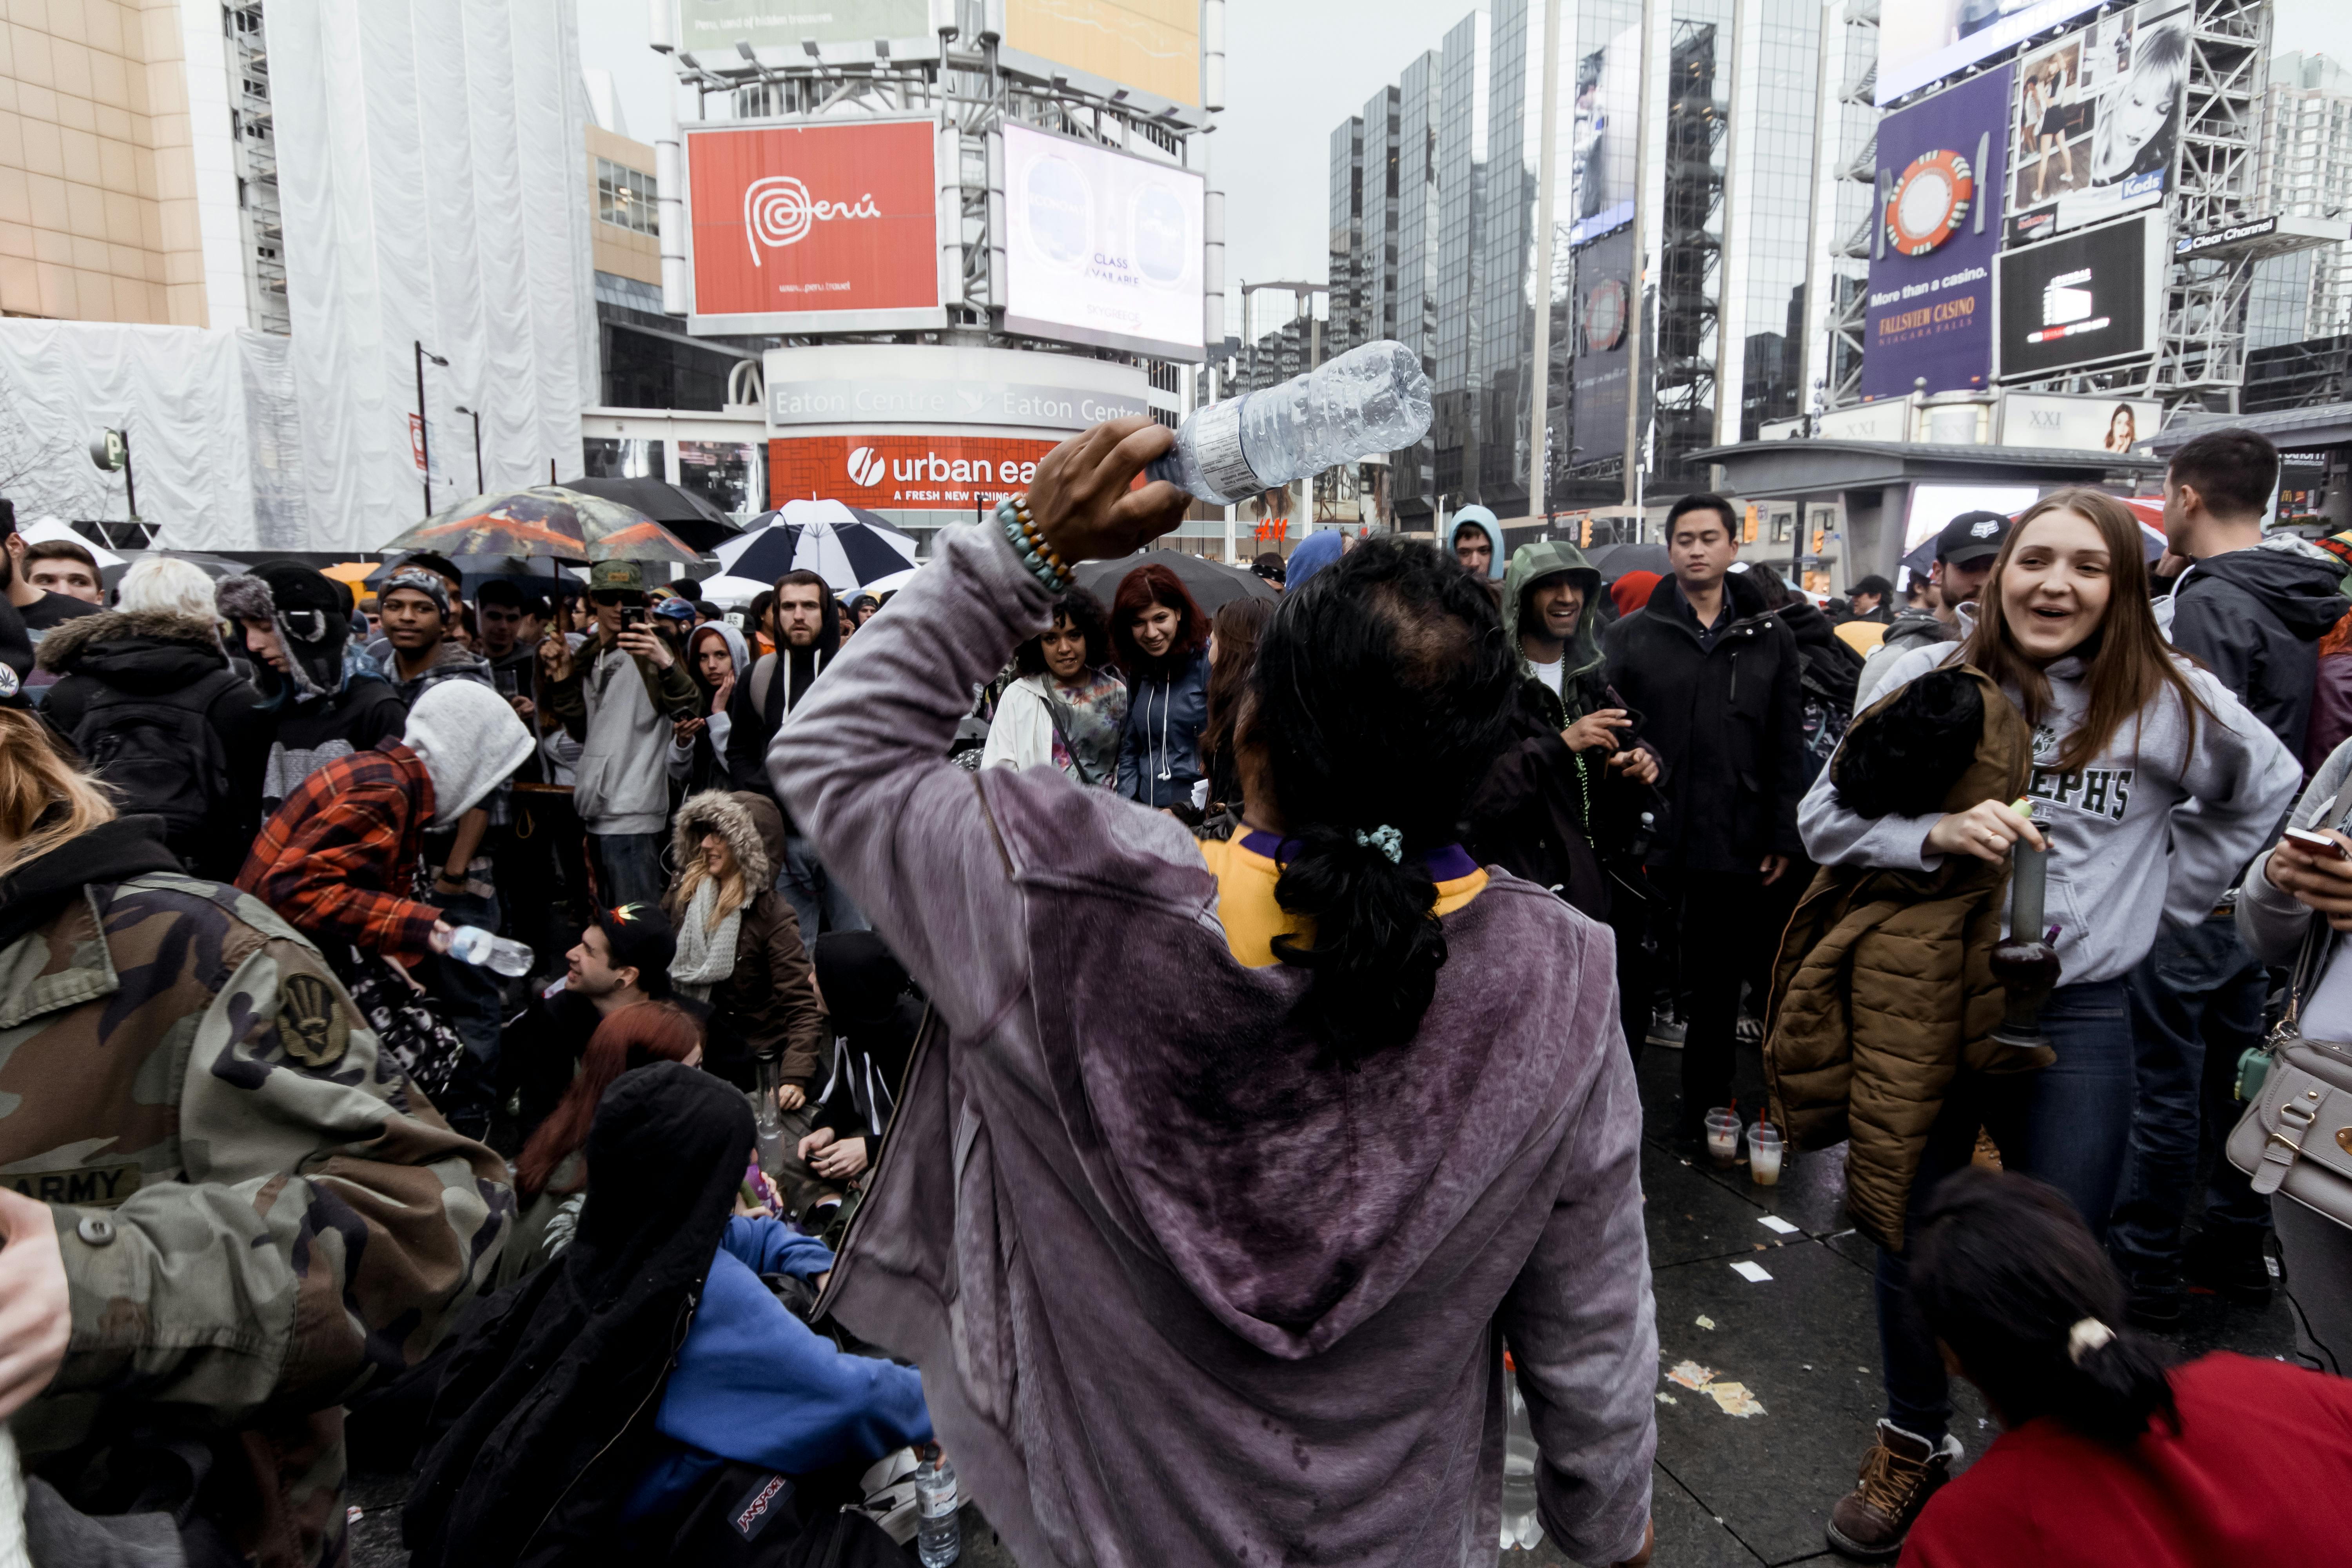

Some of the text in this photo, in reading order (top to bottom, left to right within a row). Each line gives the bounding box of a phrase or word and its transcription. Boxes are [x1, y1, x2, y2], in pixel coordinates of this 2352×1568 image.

[744, 16, 753, 29] of
[2124, 175, 2160, 197] Keds
[744, 176, 881, 267] Perú
[2192, 218, 2274, 249] Clear Channel
[1095, 253, 1128, 269] CLASS
[1870, 267, 1987, 307] More than a casino.
[1087, 304, 1140, 322] SKYGREECE
[1879, 296, 1975, 336] FALLSVIEW CASINO
[776, 389, 945, 414] Eaton Centre
[1004, 393, 1072, 419] Eaton
[1846, 420, 1876, 438] XXI
[106, 433, 122, 461] P
[893, 451, 992, 482] urban
[893, 490, 902, 501] A
[905, 490, 940, 501] FRESH
[945, 490, 969, 501] NEW
[1254, 517, 1288, 543] H&M
[15, 1168, 124, 1203] ARMY
[737, 1474, 787, 1534] JANSPORT
